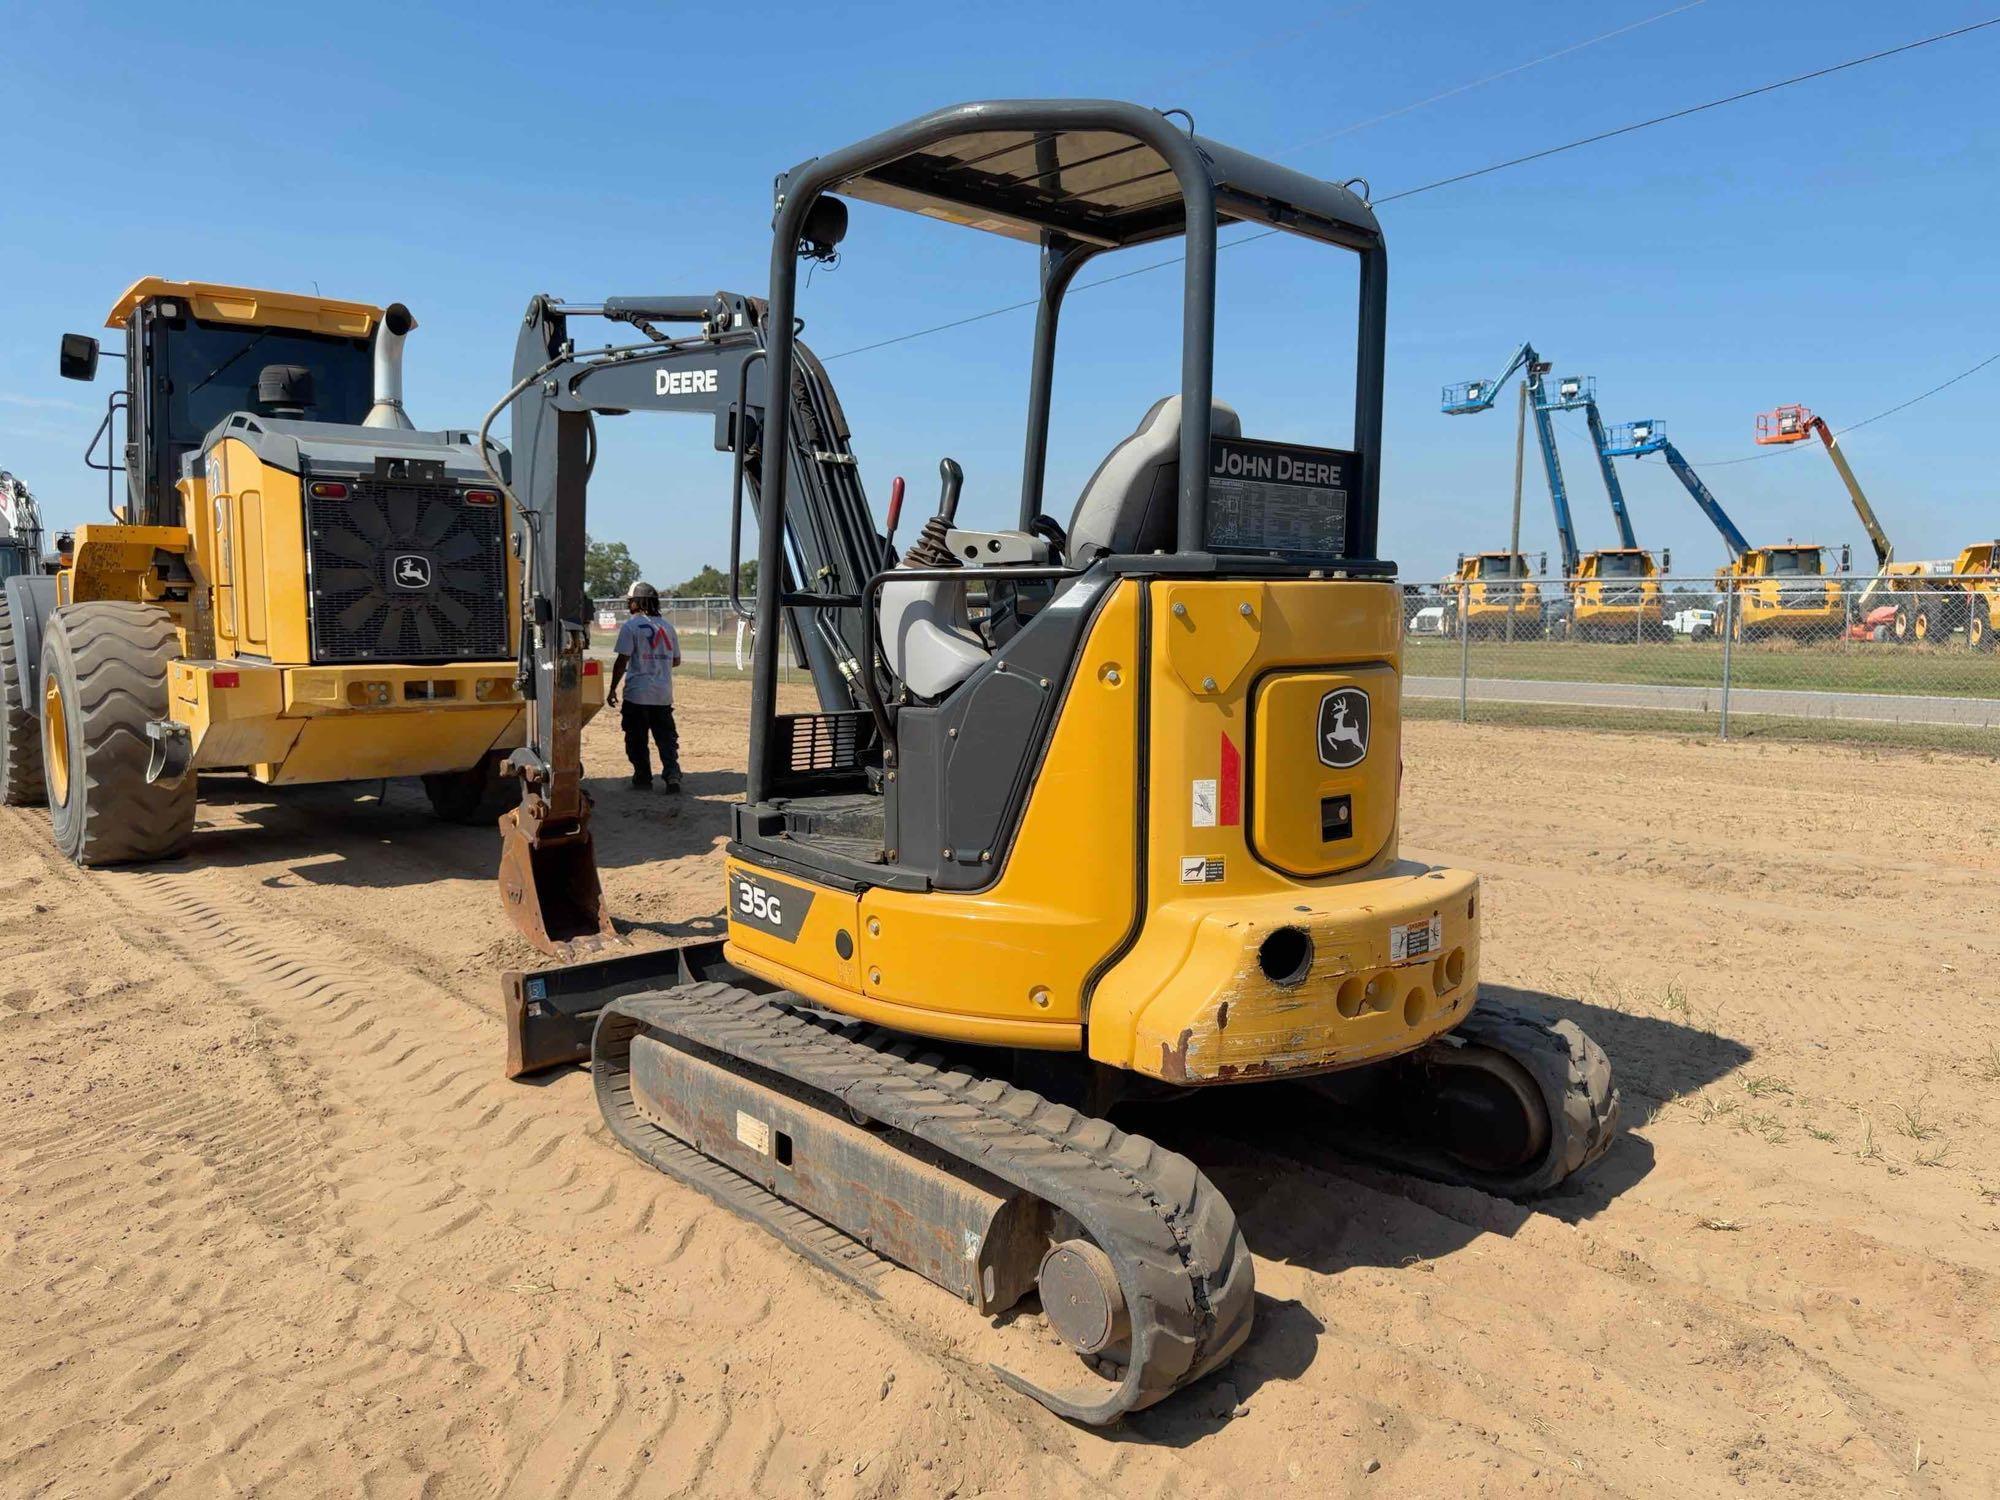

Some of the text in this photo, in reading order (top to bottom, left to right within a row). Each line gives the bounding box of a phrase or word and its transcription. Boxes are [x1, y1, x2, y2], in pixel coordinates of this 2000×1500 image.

[656, 369, 718, 395] DEERE
[1214, 448, 1342, 486] JOHN DEERE
[739, 882, 782, 925] 35G
